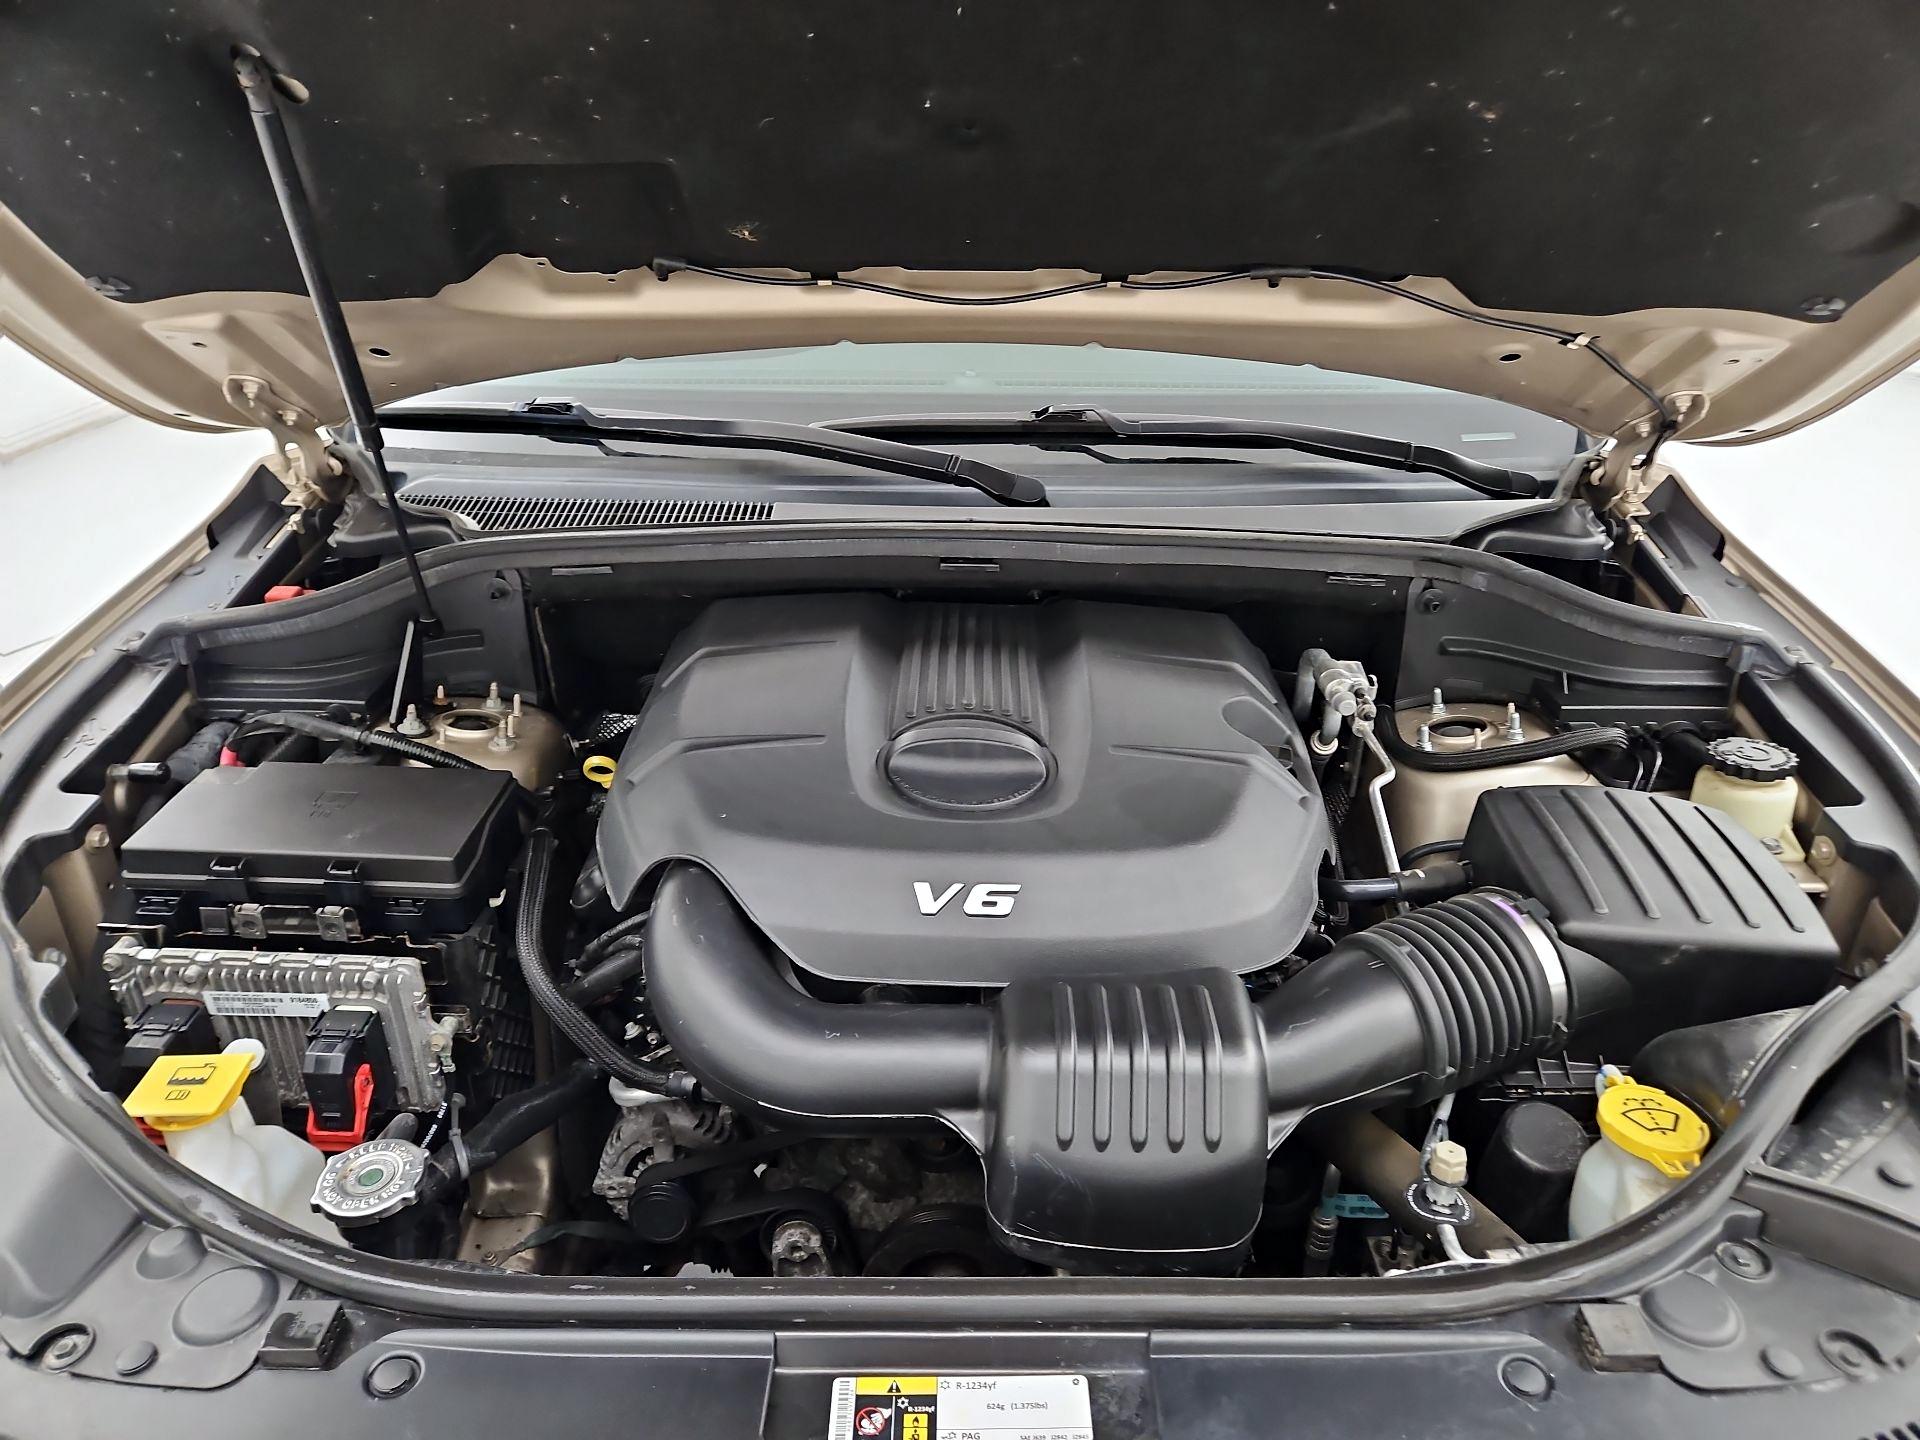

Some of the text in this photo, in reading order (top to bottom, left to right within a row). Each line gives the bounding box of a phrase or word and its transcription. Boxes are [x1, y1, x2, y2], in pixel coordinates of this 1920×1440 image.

[912, 881, 1022, 918] V6
[341, 1197, 380, 1210] OPEN
[956, 1381, 997, 1391] R-1234yf
[986, 1401, 1049, 1411] 624g (1.375lbs)
[961, 1432, 981, 1440] PAG
